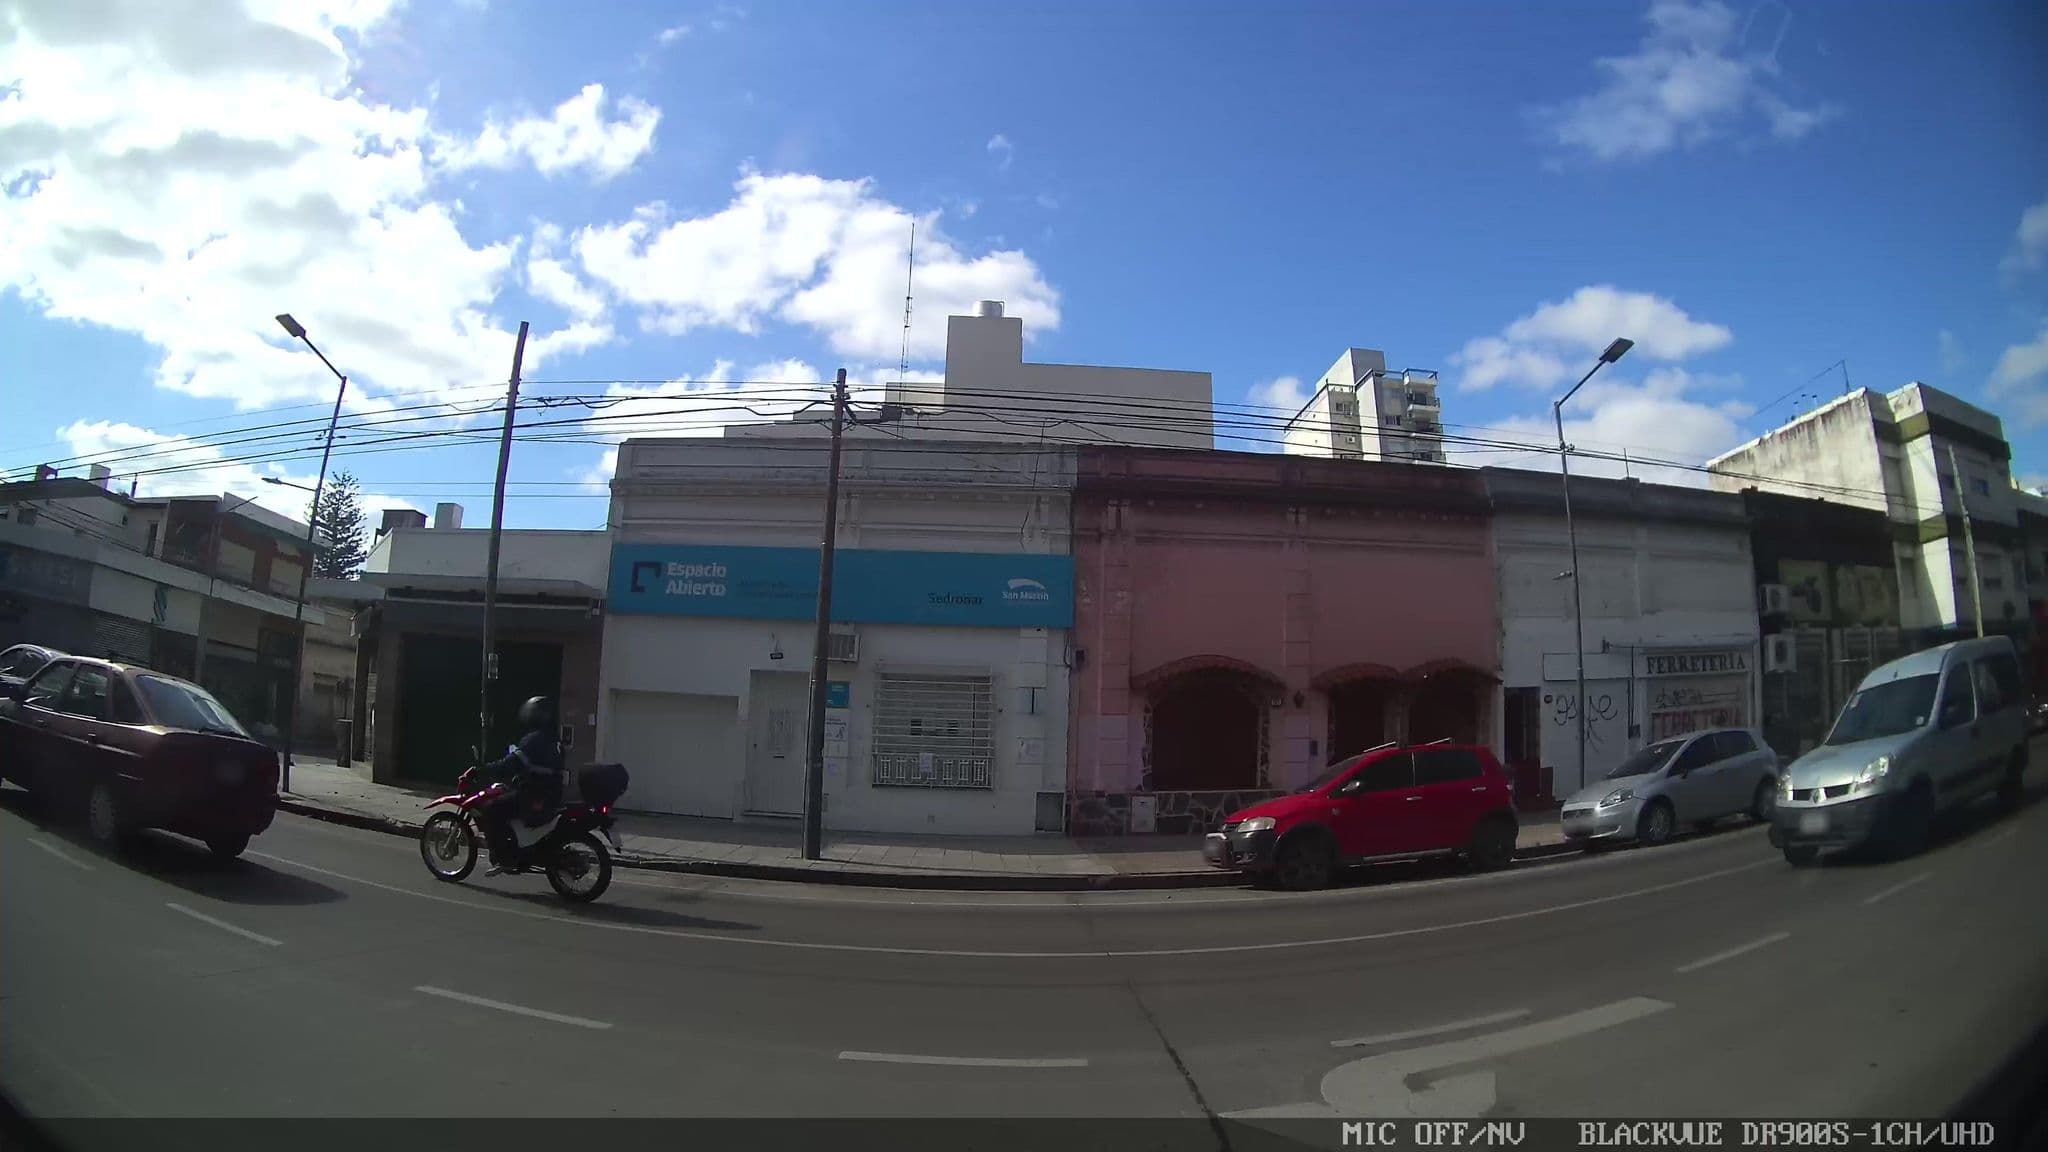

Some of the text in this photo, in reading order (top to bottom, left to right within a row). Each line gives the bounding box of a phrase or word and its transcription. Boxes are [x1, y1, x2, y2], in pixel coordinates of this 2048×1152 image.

[667, 561, 727, 580] Espacio
[665, 579, 726, 597] Abierto
[1000, 591, 1018, 601] San
